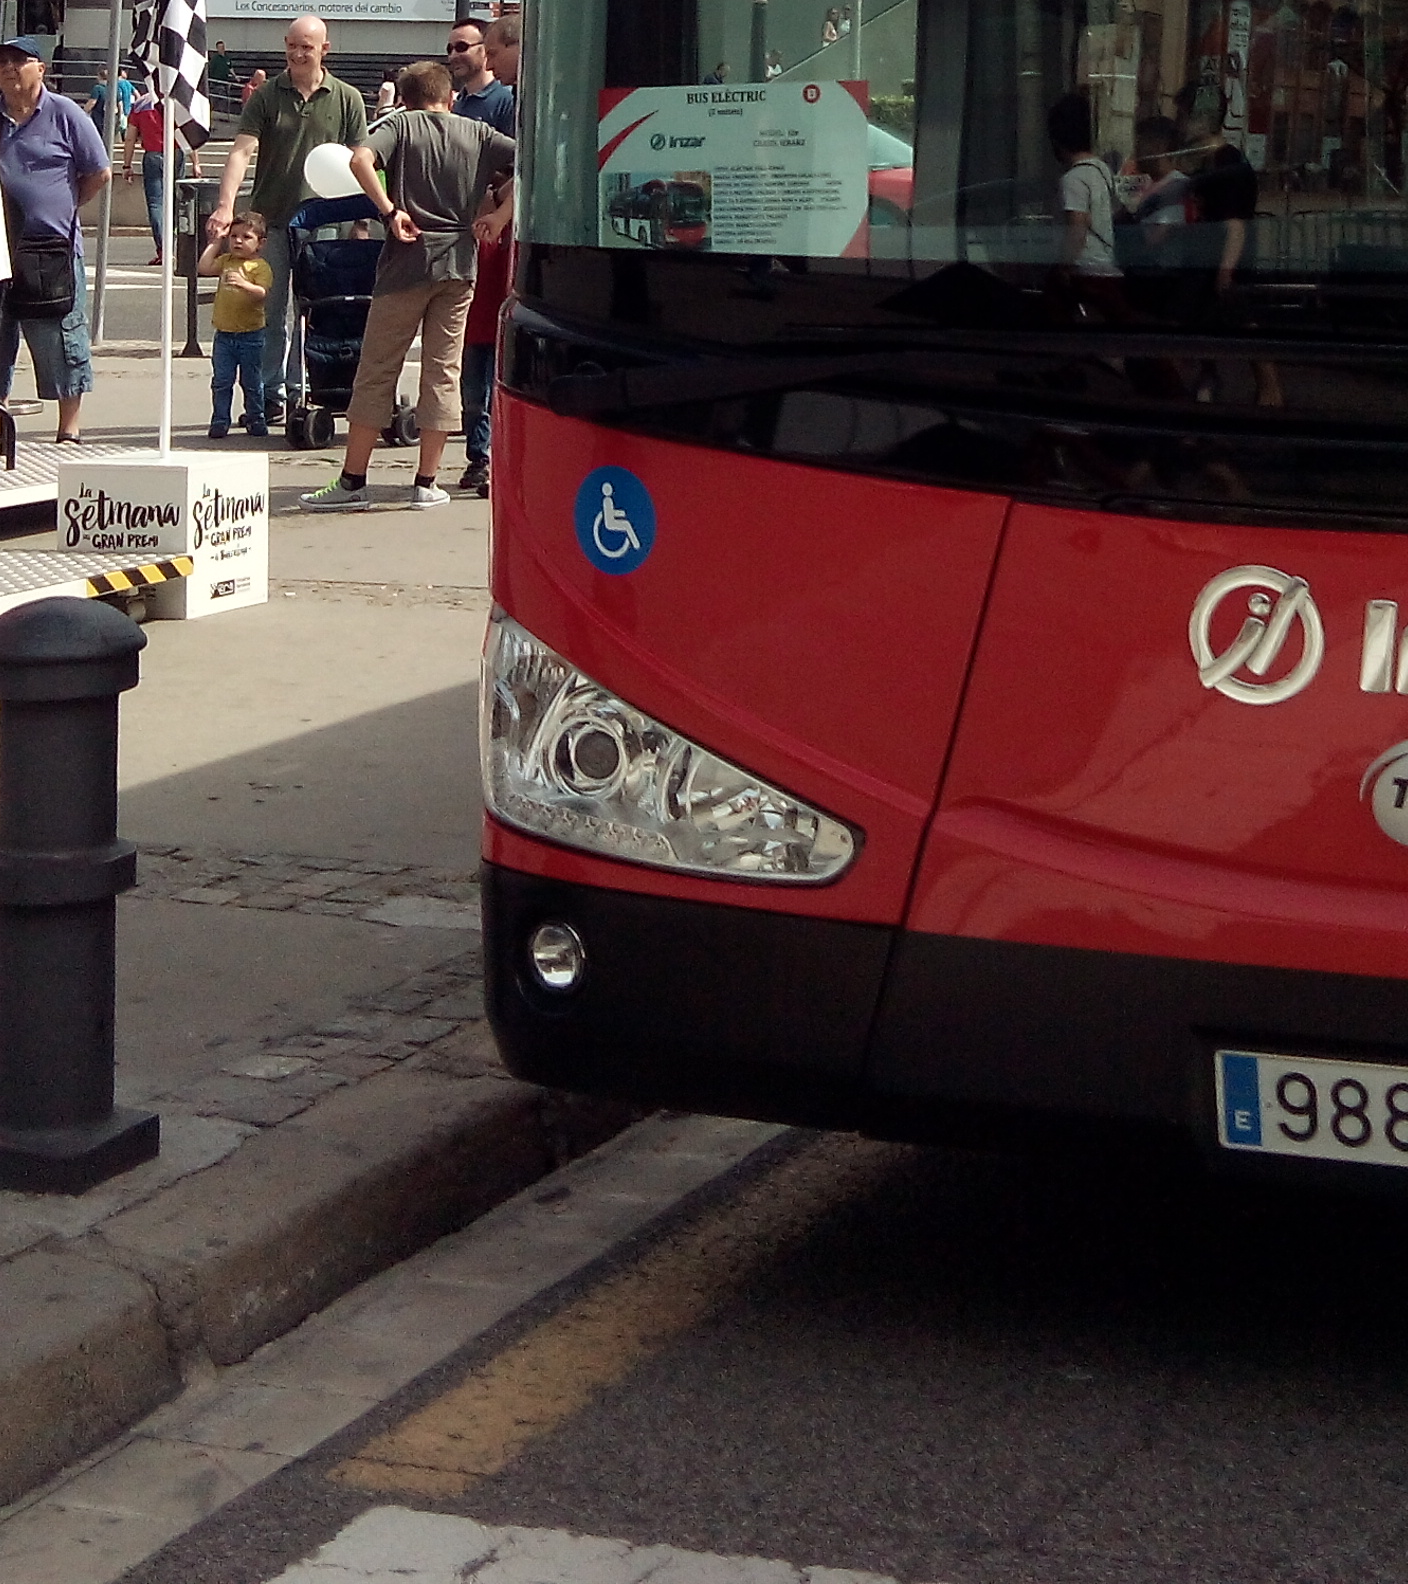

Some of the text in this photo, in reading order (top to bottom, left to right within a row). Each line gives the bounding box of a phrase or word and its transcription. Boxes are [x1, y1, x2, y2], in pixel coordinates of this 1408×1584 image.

[318, 2, 353, 13] motores
[370, 2, 403, 14] cambio
[687, 92, 709, 104] BUS
[78, 481, 93, 499] La
[64, 489, 181, 548] Setmana
[192, 488, 266, 550] Setmana
[92, 531, 160, 551] GRAN PREMI
[1234, 1110, 1252, 1132] E
